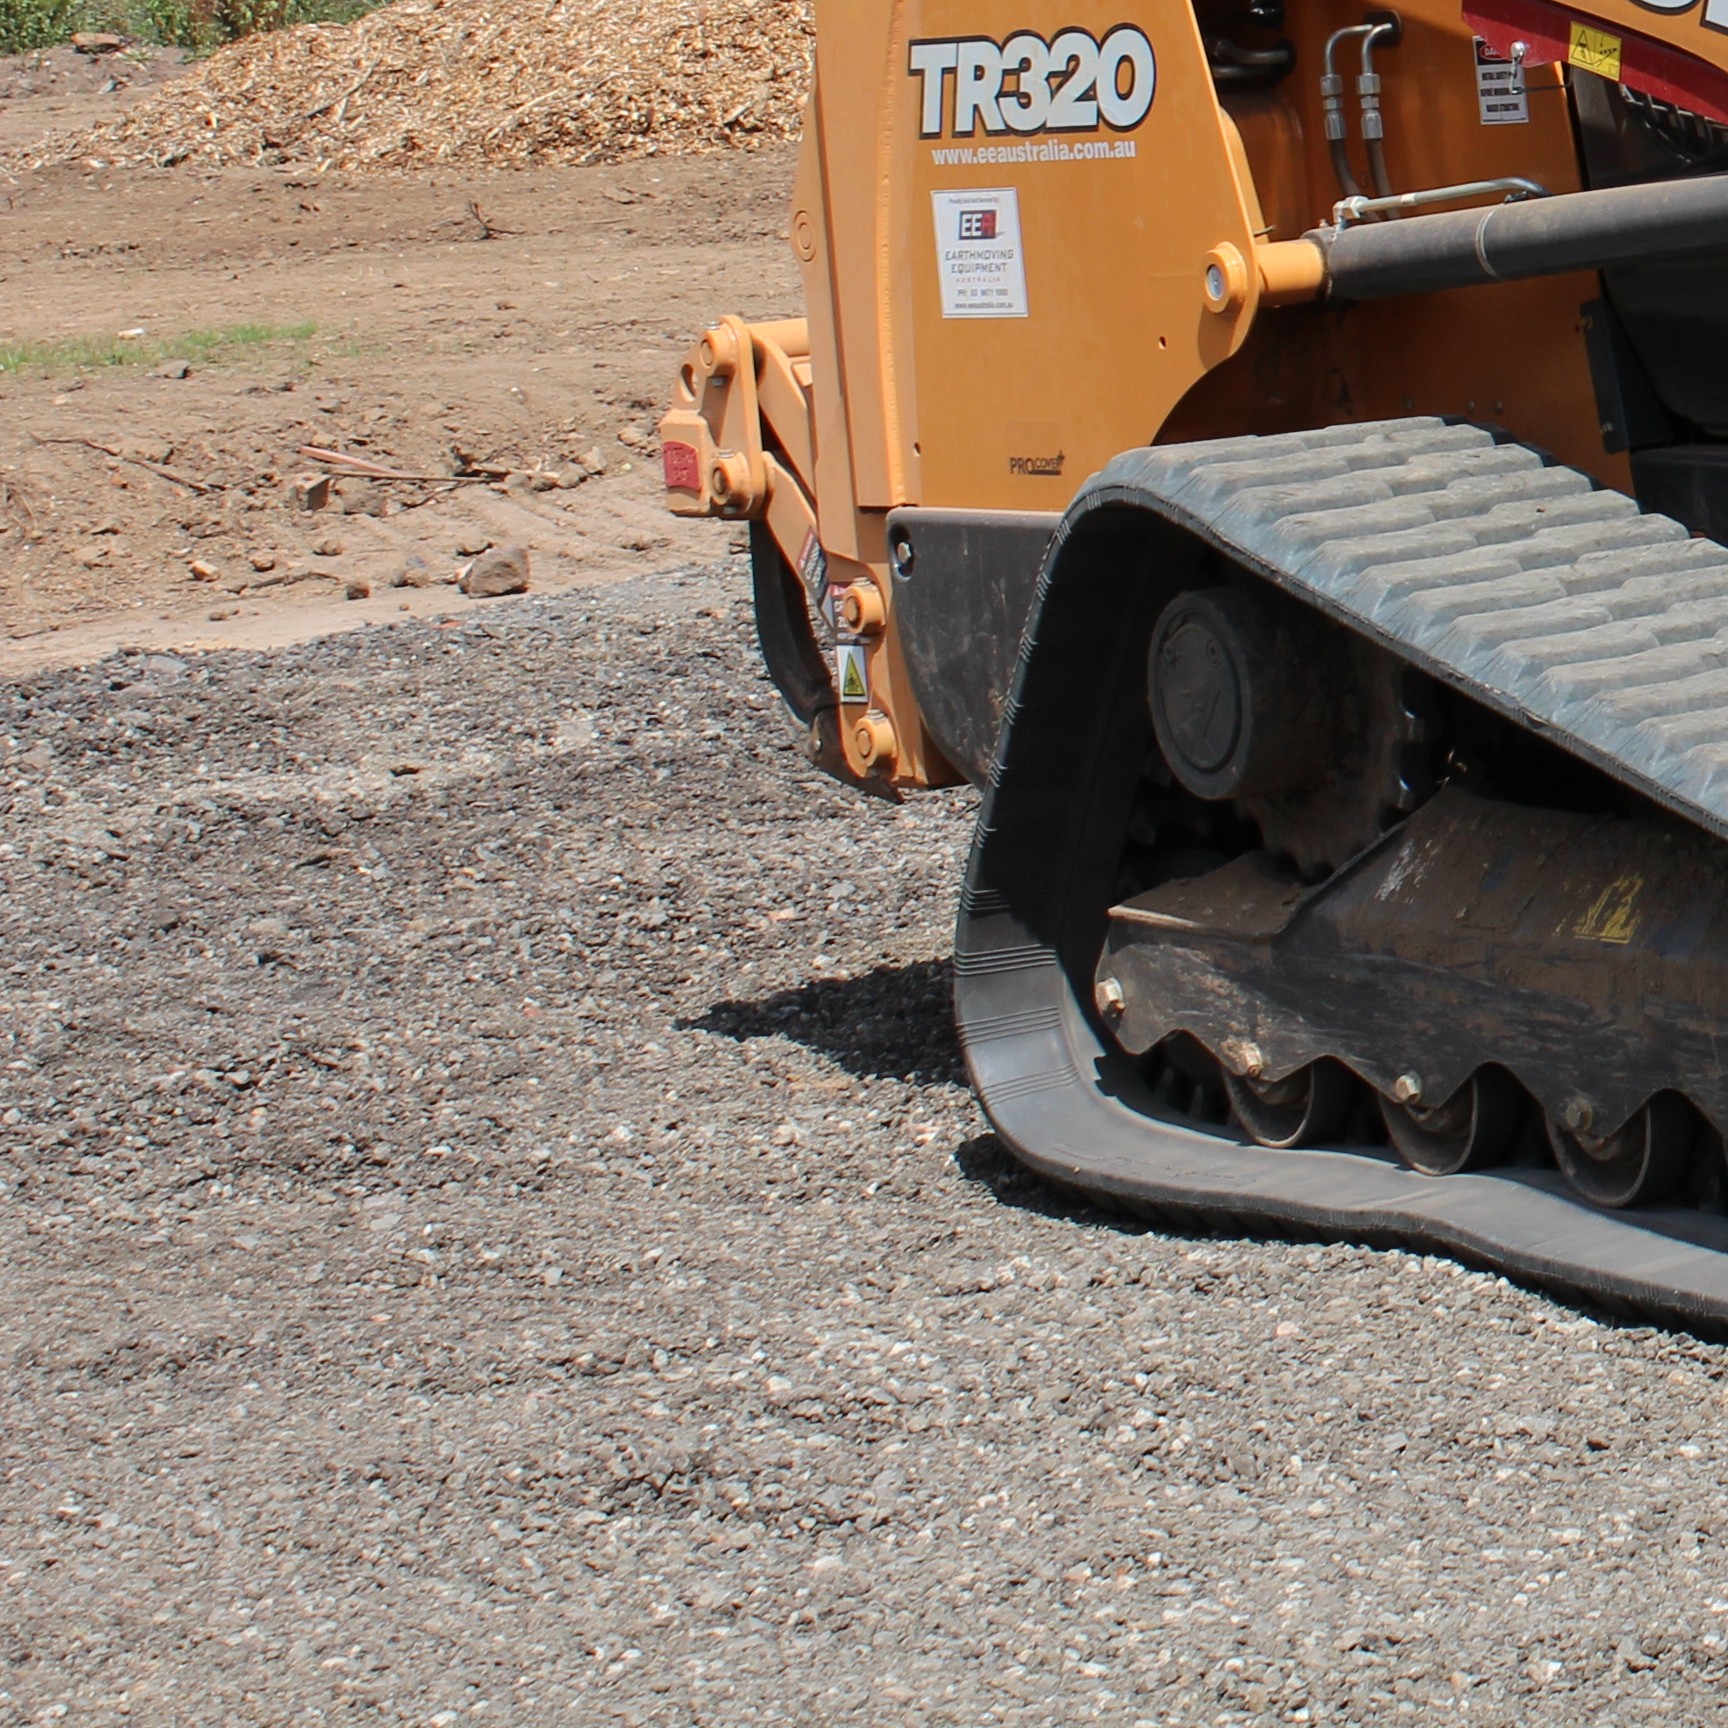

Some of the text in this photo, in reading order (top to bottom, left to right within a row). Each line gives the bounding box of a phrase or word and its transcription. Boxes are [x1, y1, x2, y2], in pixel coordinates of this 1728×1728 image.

[908, 22, 1157, 140] TR320
[931, 139, 1137, 165] www.eeaustralia.com.au
[945, 249, 1014, 261] EARTHMOVING
[951, 263, 1008, 274] EQUIPMENT
